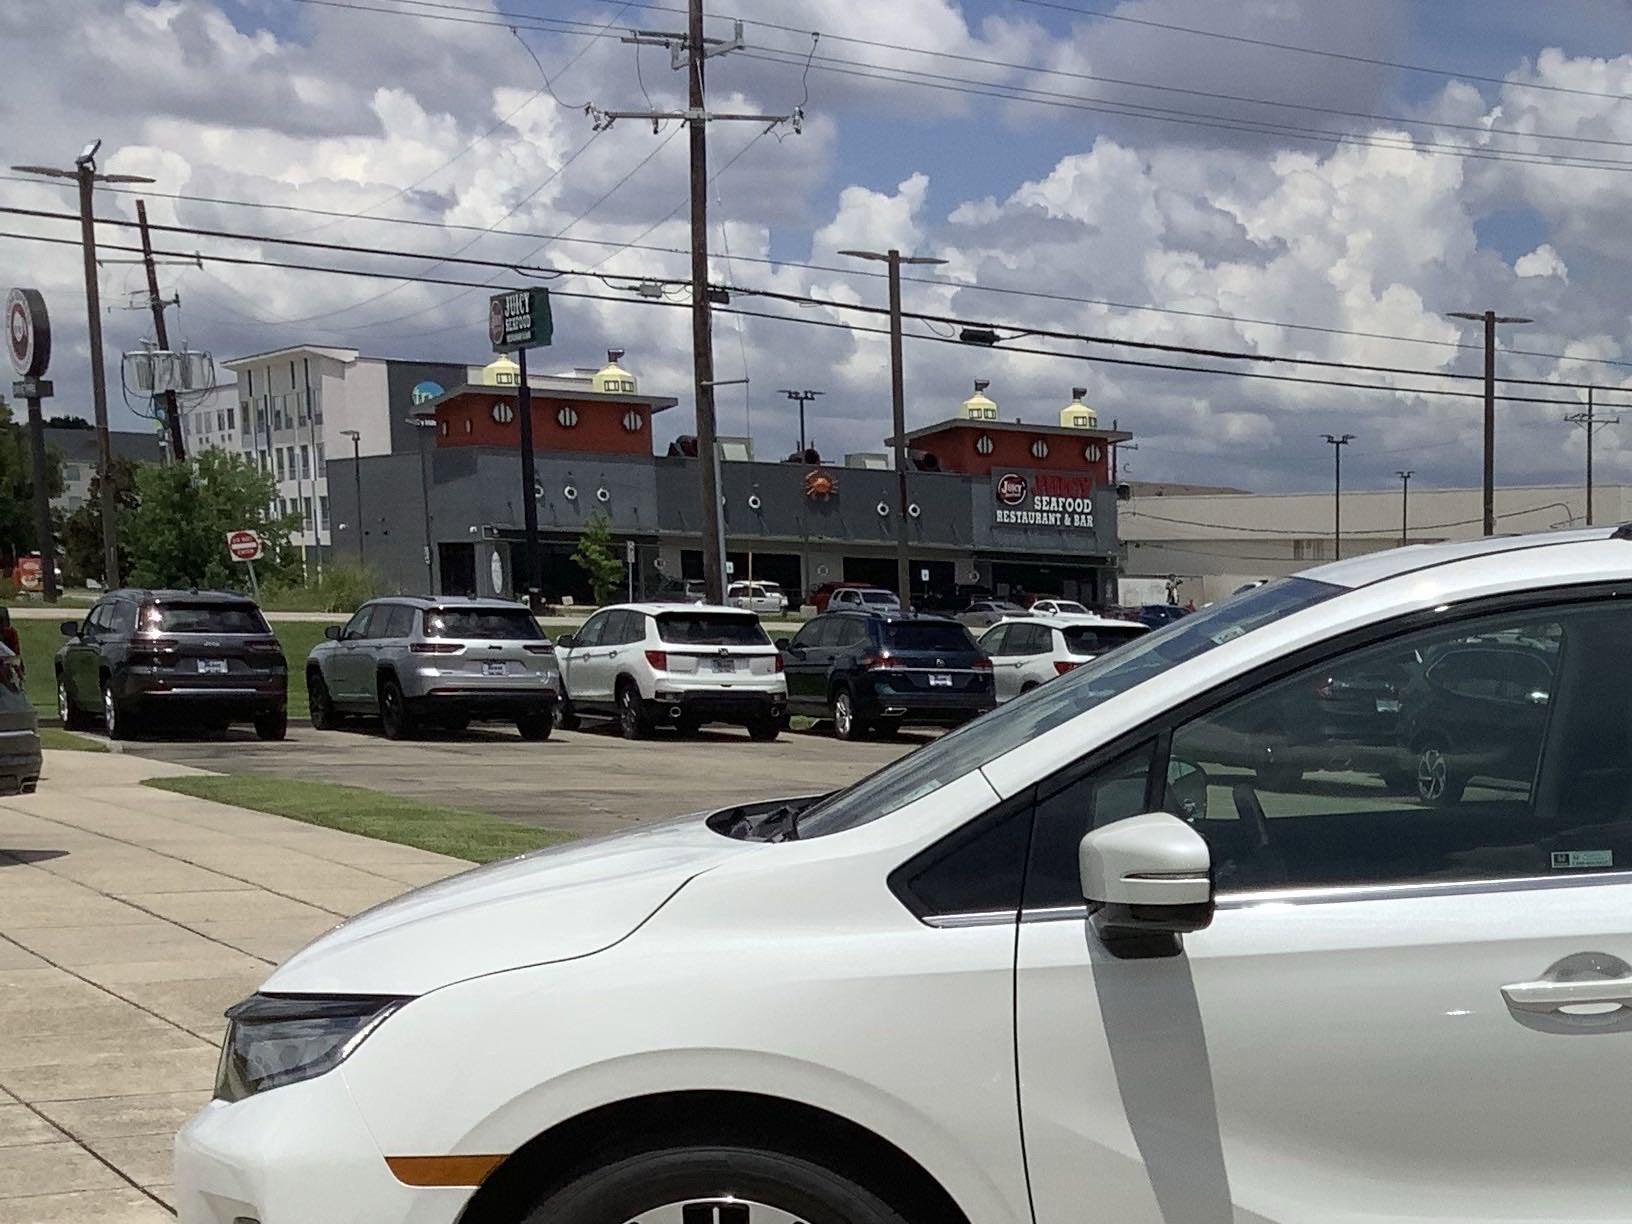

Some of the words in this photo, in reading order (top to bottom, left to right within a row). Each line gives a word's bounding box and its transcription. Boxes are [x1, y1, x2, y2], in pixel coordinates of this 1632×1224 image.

[504, 292, 530, 317] JUICY
[1034, 496, 1092, 513] SEAFOOD
[996, 510, 1062, 525] RESTAURANT
[1063, 514, 1072, 526] &
[1073, 514, 1094, 527] BAR
